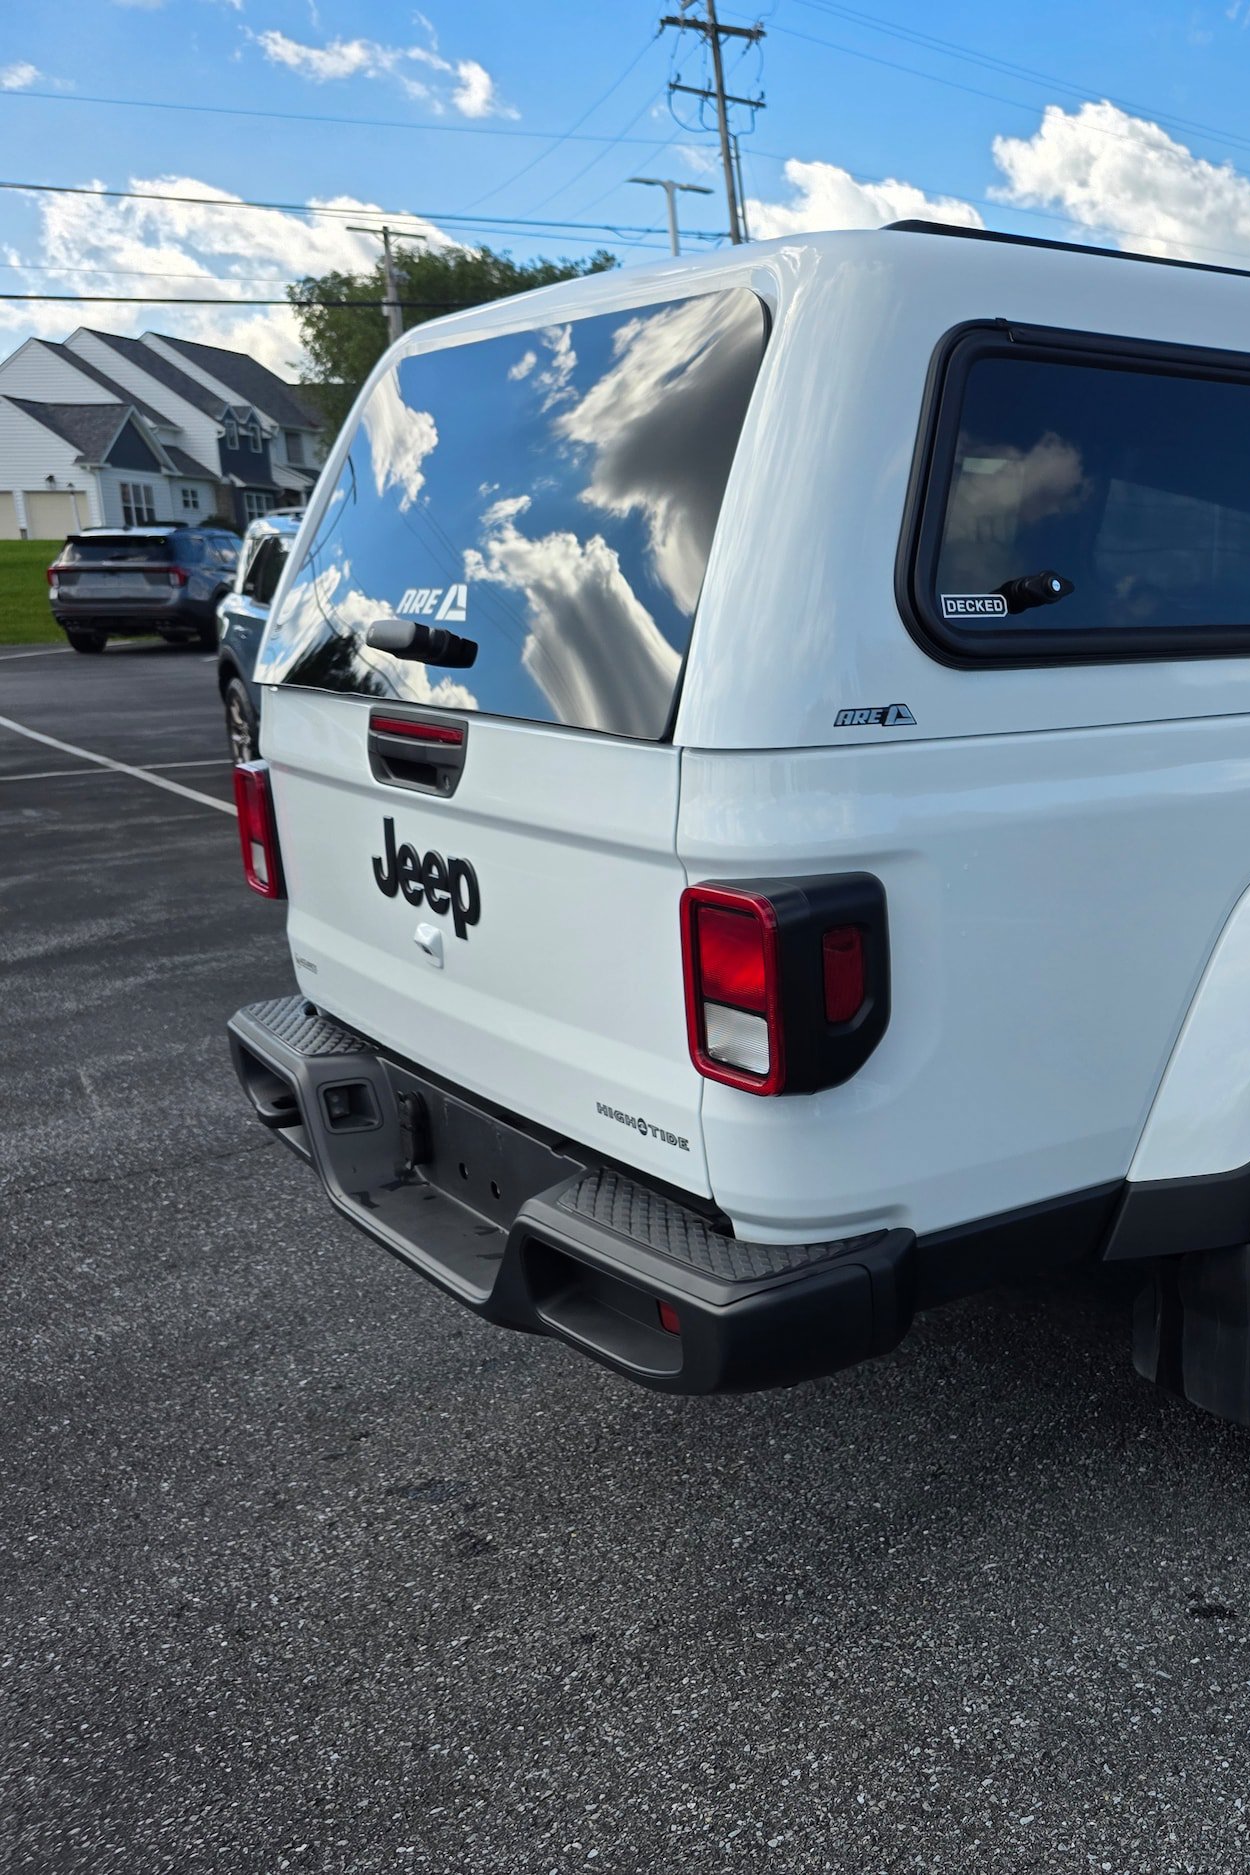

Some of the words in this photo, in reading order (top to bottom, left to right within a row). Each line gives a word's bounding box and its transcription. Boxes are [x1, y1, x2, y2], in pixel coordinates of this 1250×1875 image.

[946, 600, 1003, 612] DECKED
[371, 815, 481, 941] Jeep
[596, 1101, 637, 1129] HIGH
[648, 1124, 690, 1152] TIDE
